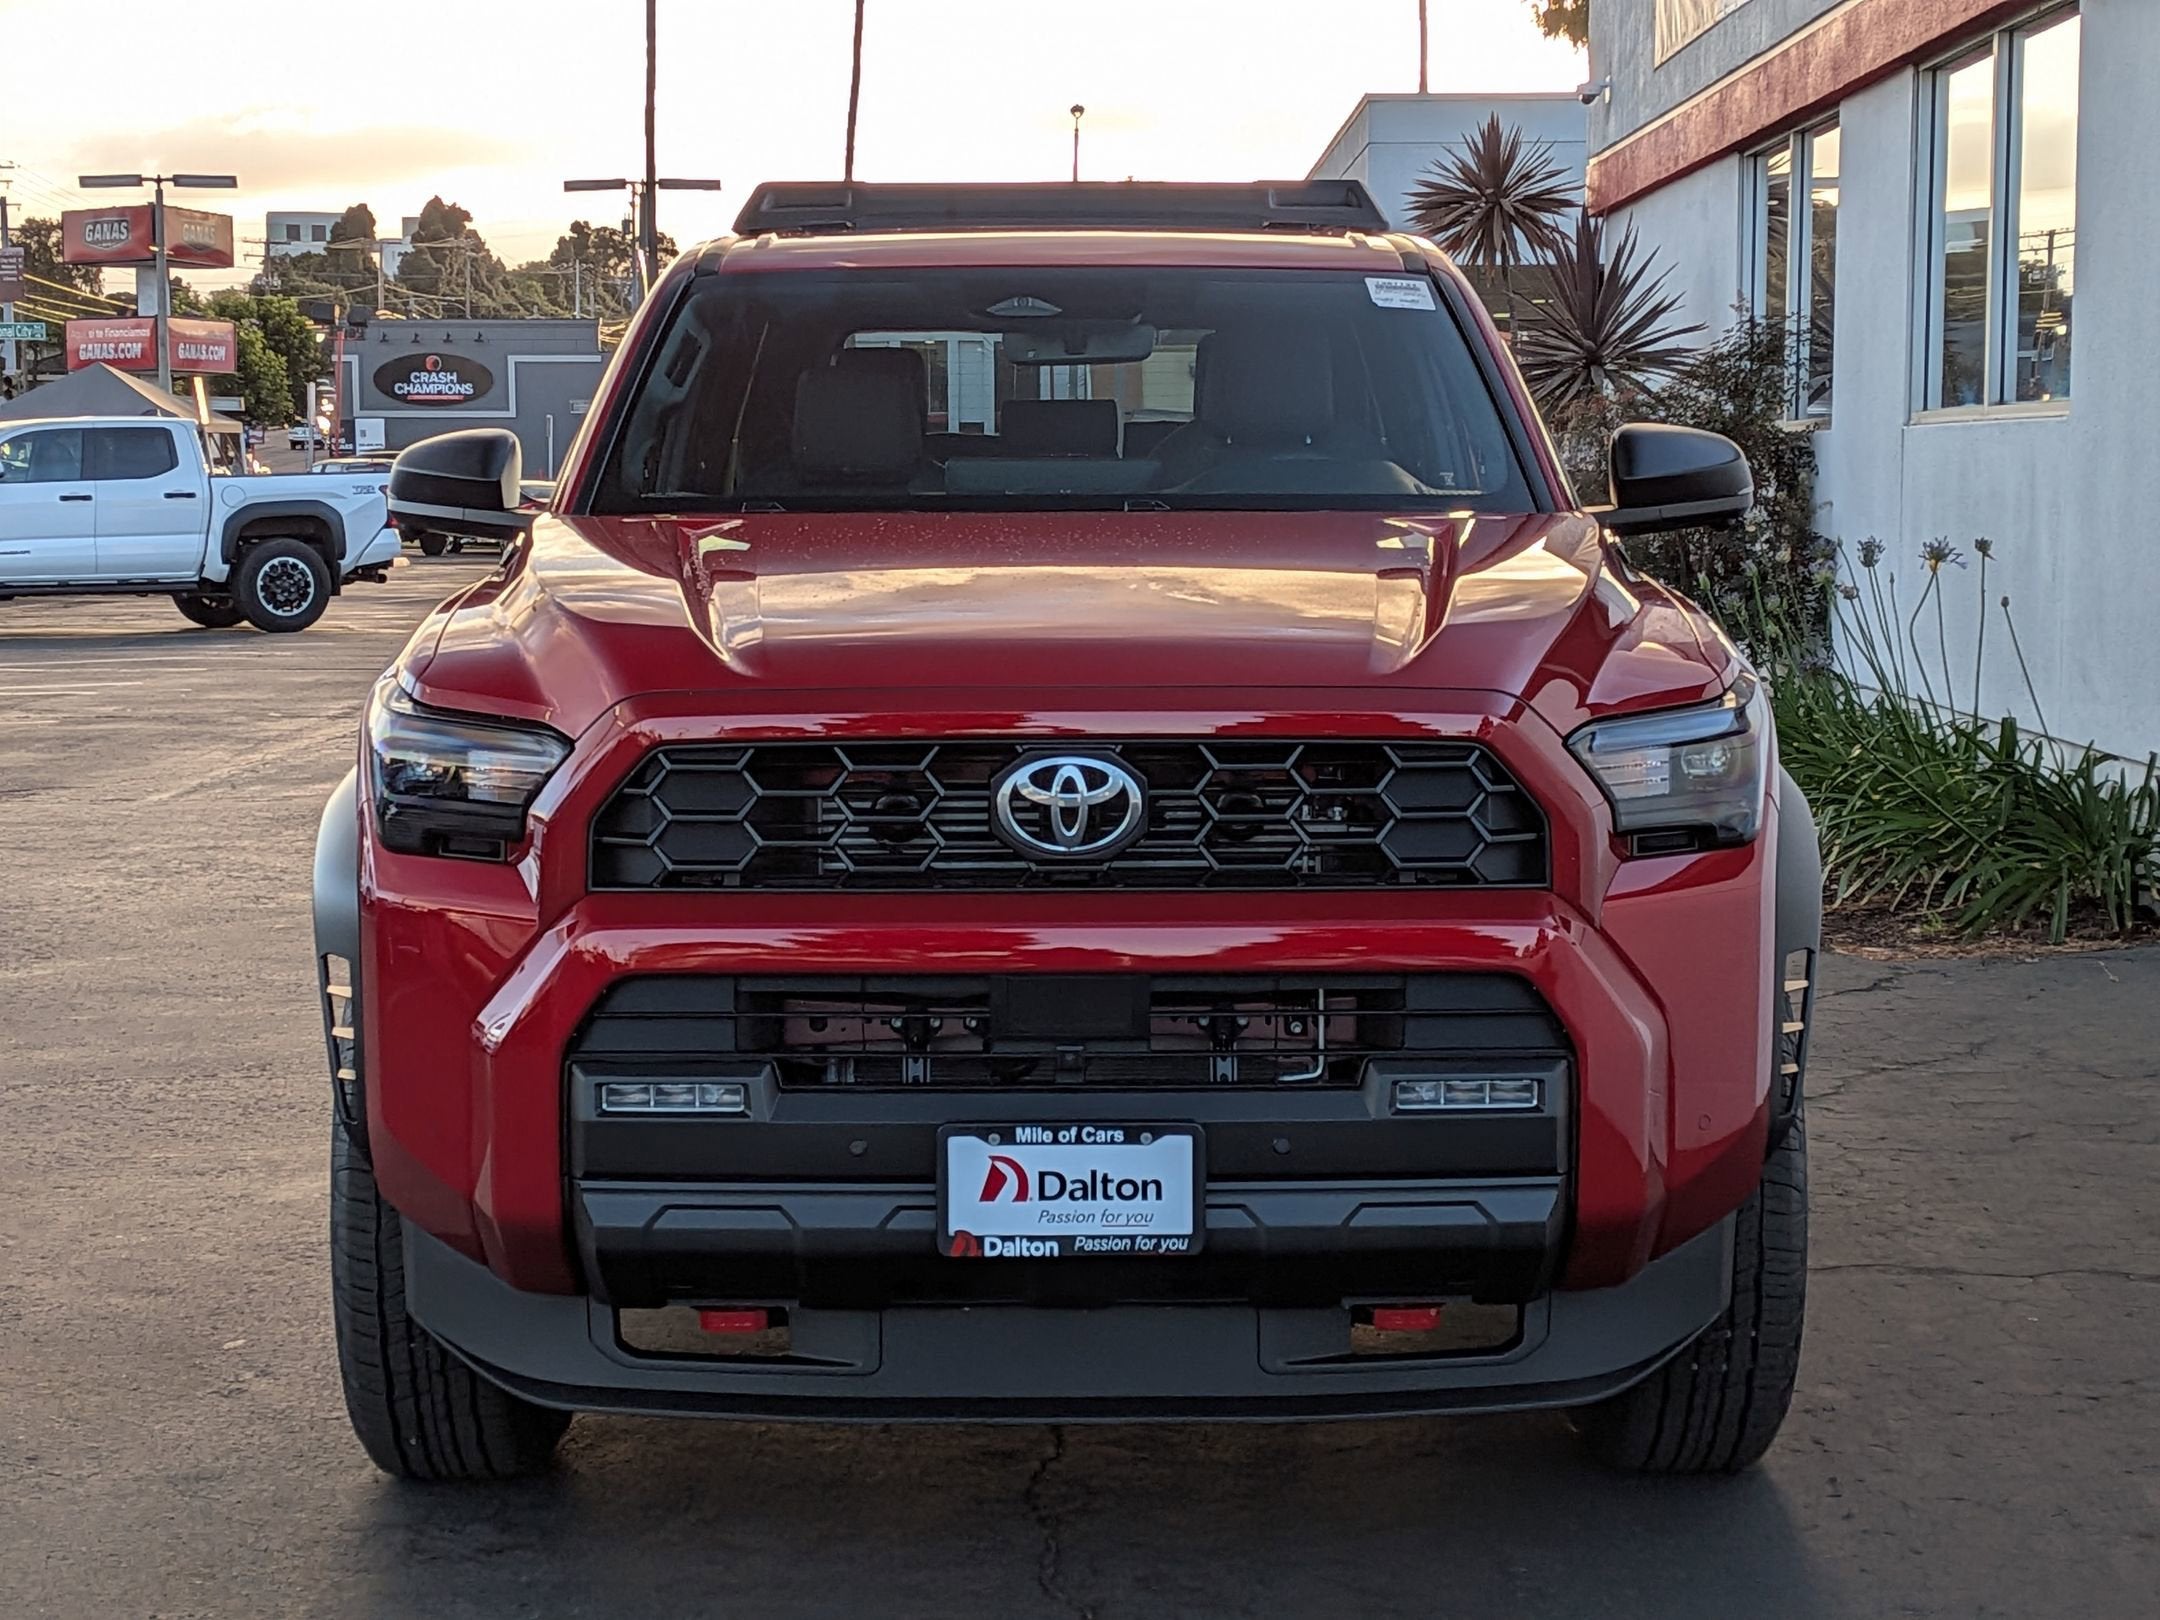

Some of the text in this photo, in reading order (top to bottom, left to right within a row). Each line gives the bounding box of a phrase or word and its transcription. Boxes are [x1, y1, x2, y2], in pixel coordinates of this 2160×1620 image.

[85, 222, 128, 241] GANAS
[79, 343, 142, 360] GANAS.COM
[178, 343, 226, 360] GANAS.COM
[410, 372, 457, 383] CRASH
[394, 383, 474, 395] CHAMPIONS
[1015, 1127, 1124, 1143] Mile of Cars
[1038, 1170, 1162, 1200] Dalton
[1038, 1209, 1154, 1226] Passion for you
[984, 1237, 1059, 1257] Dalton
[1074, 1235, 1188, 1253] Passion for you
